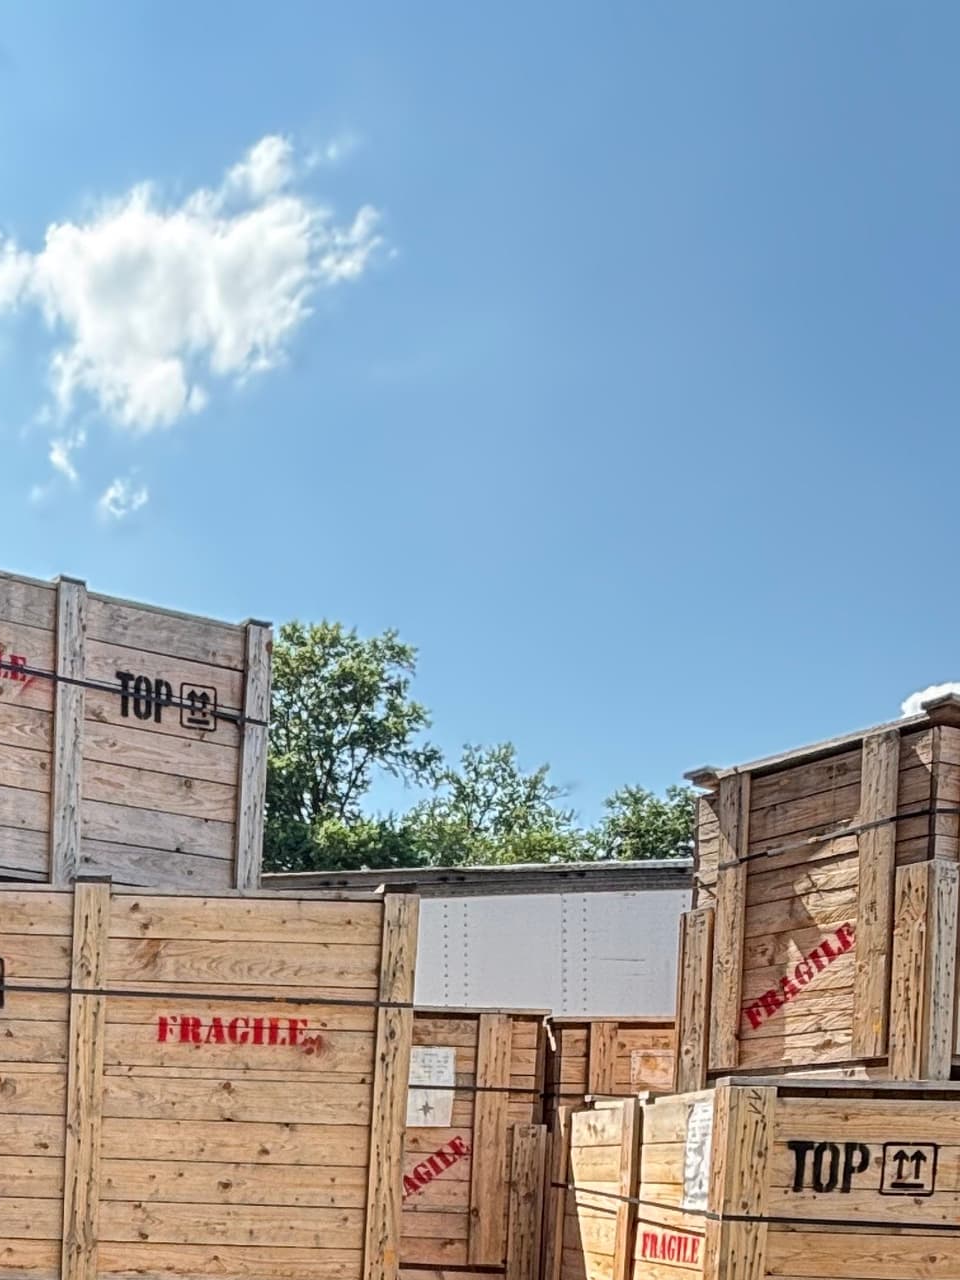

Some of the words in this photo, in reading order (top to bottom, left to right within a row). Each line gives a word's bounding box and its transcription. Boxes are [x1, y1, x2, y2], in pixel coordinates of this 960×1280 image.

[115, 670, 173, 723] TOP
[744, 921, 855, 1030] FRAGILE
[157, 1015, 308, 1046] FRAGILE
[401, 1135, 470, 1201] AGILE
[787, 1140, 870, 1194] TOP
[641, 1231, 701, 1265] FRAGILE
